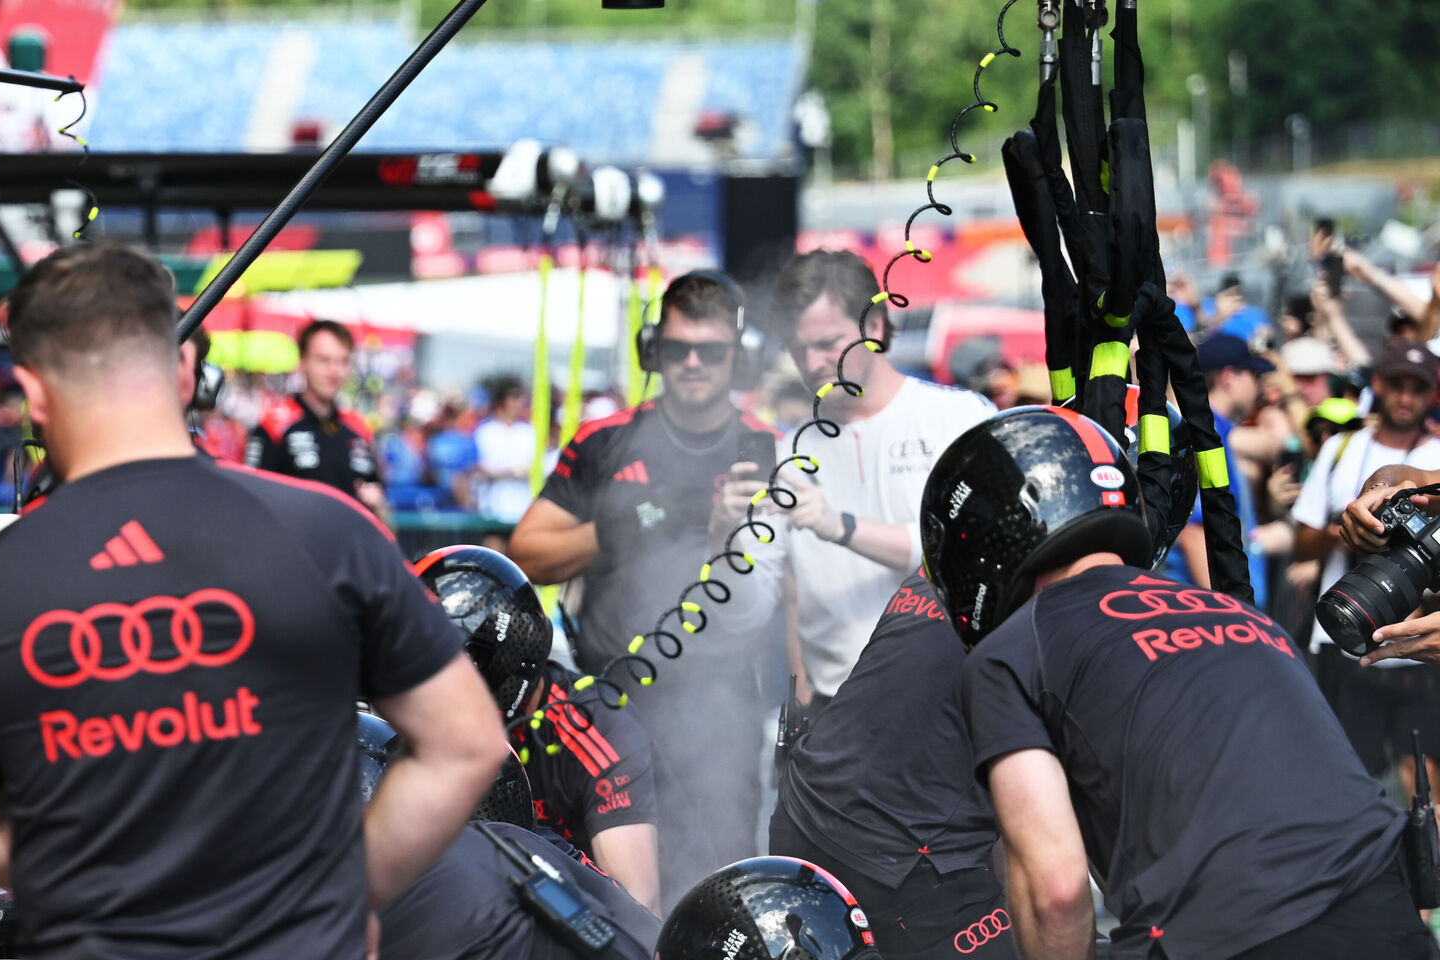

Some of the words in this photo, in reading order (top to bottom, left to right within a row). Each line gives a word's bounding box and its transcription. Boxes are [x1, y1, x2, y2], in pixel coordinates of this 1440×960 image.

[1095, 472, 1121, 482] BELL
[948, 485, 972, 520] QATAR
[971, 583, 987, 620] Castrol
[39, 686, 262, 763] Revolut
[721, 928, 740, 953] visit
